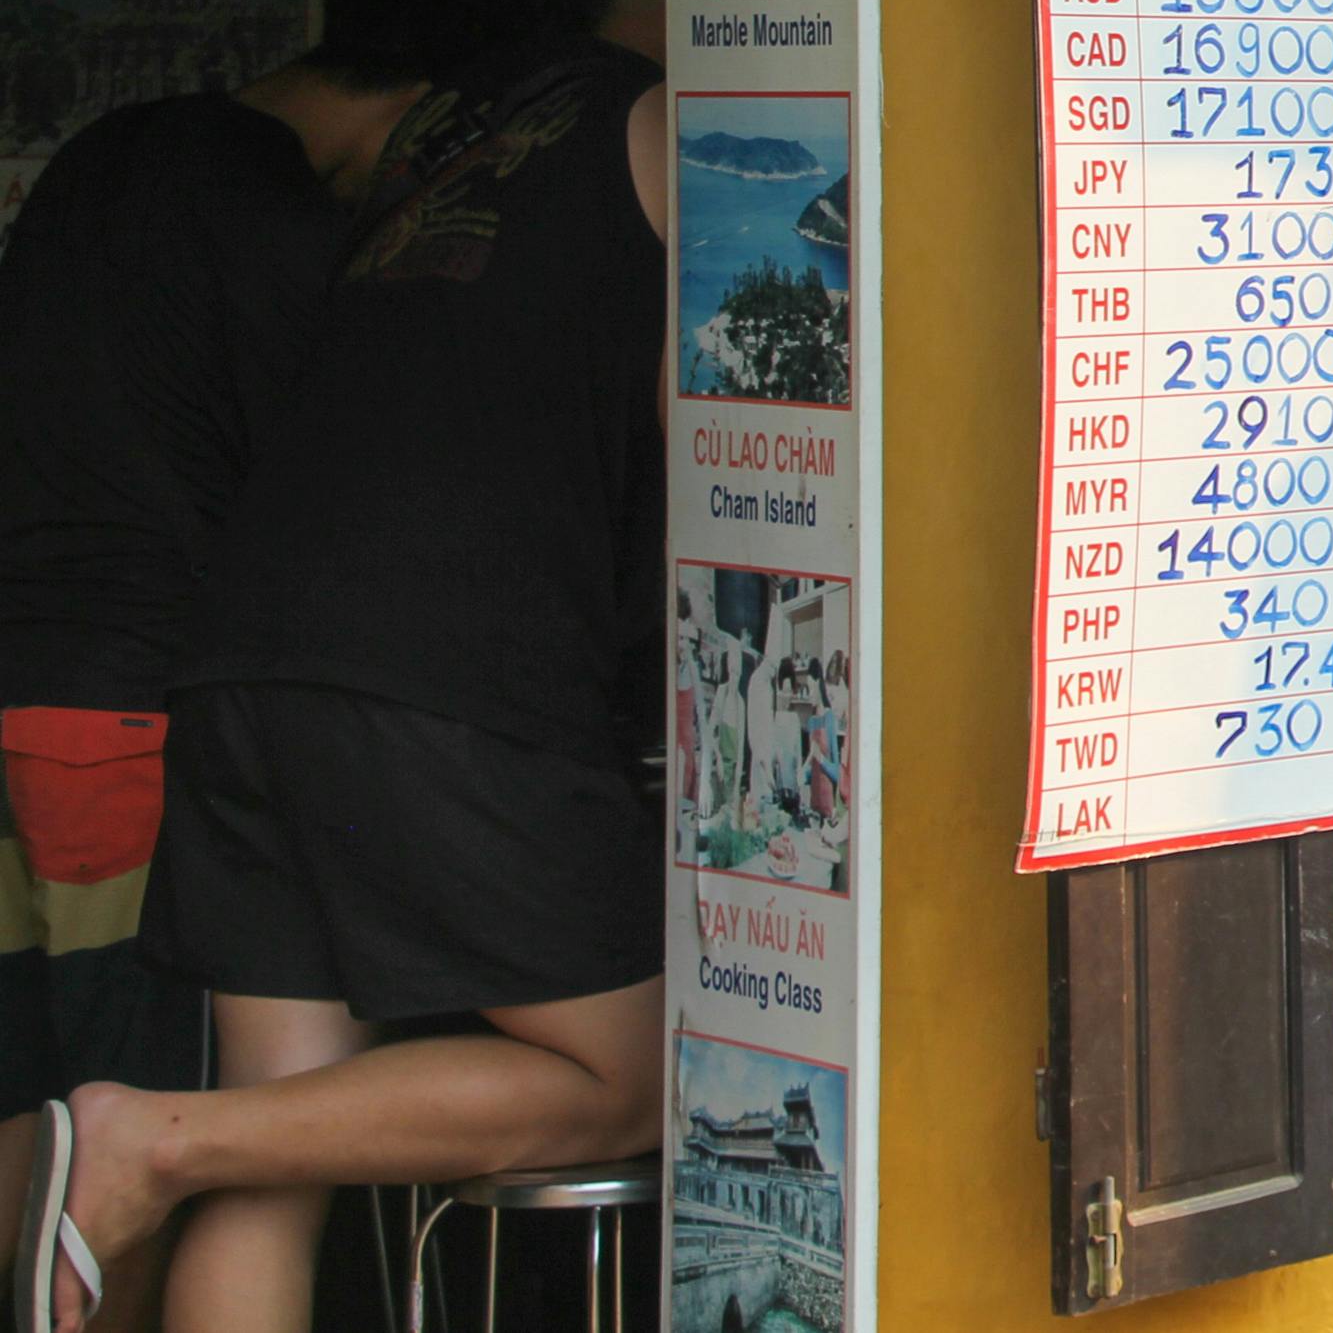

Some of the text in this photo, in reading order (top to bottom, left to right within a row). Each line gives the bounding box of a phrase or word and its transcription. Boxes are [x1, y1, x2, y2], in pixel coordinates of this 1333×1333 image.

[691, 13, 832, 47] Marble Mountain
[1067, 31, 1127, 67] CAD
[1068, 95, 1130, 131] SGD
[1074, 146, 1333, 199] JPY 173
[1072, 223, 1132, 259] CNY
[1072, 273, 1332, 327] THB 650
[694, 419, 835, 477] CÙ LAO CHÀM
[710, 484, 816, 526] Cham Island
[1065, 541, 1124, 580] NZD
[1063, 579, 1329, 644] PHP 340
[1057, 668, 1123, 709] KRW
[1056, 698, 1322, 773] TWD 730
[1057, 795, 1113, 838] LAK
[796, 908, 825, 961] ĂN
[699, 955, 822, 1013] Cooking Class
